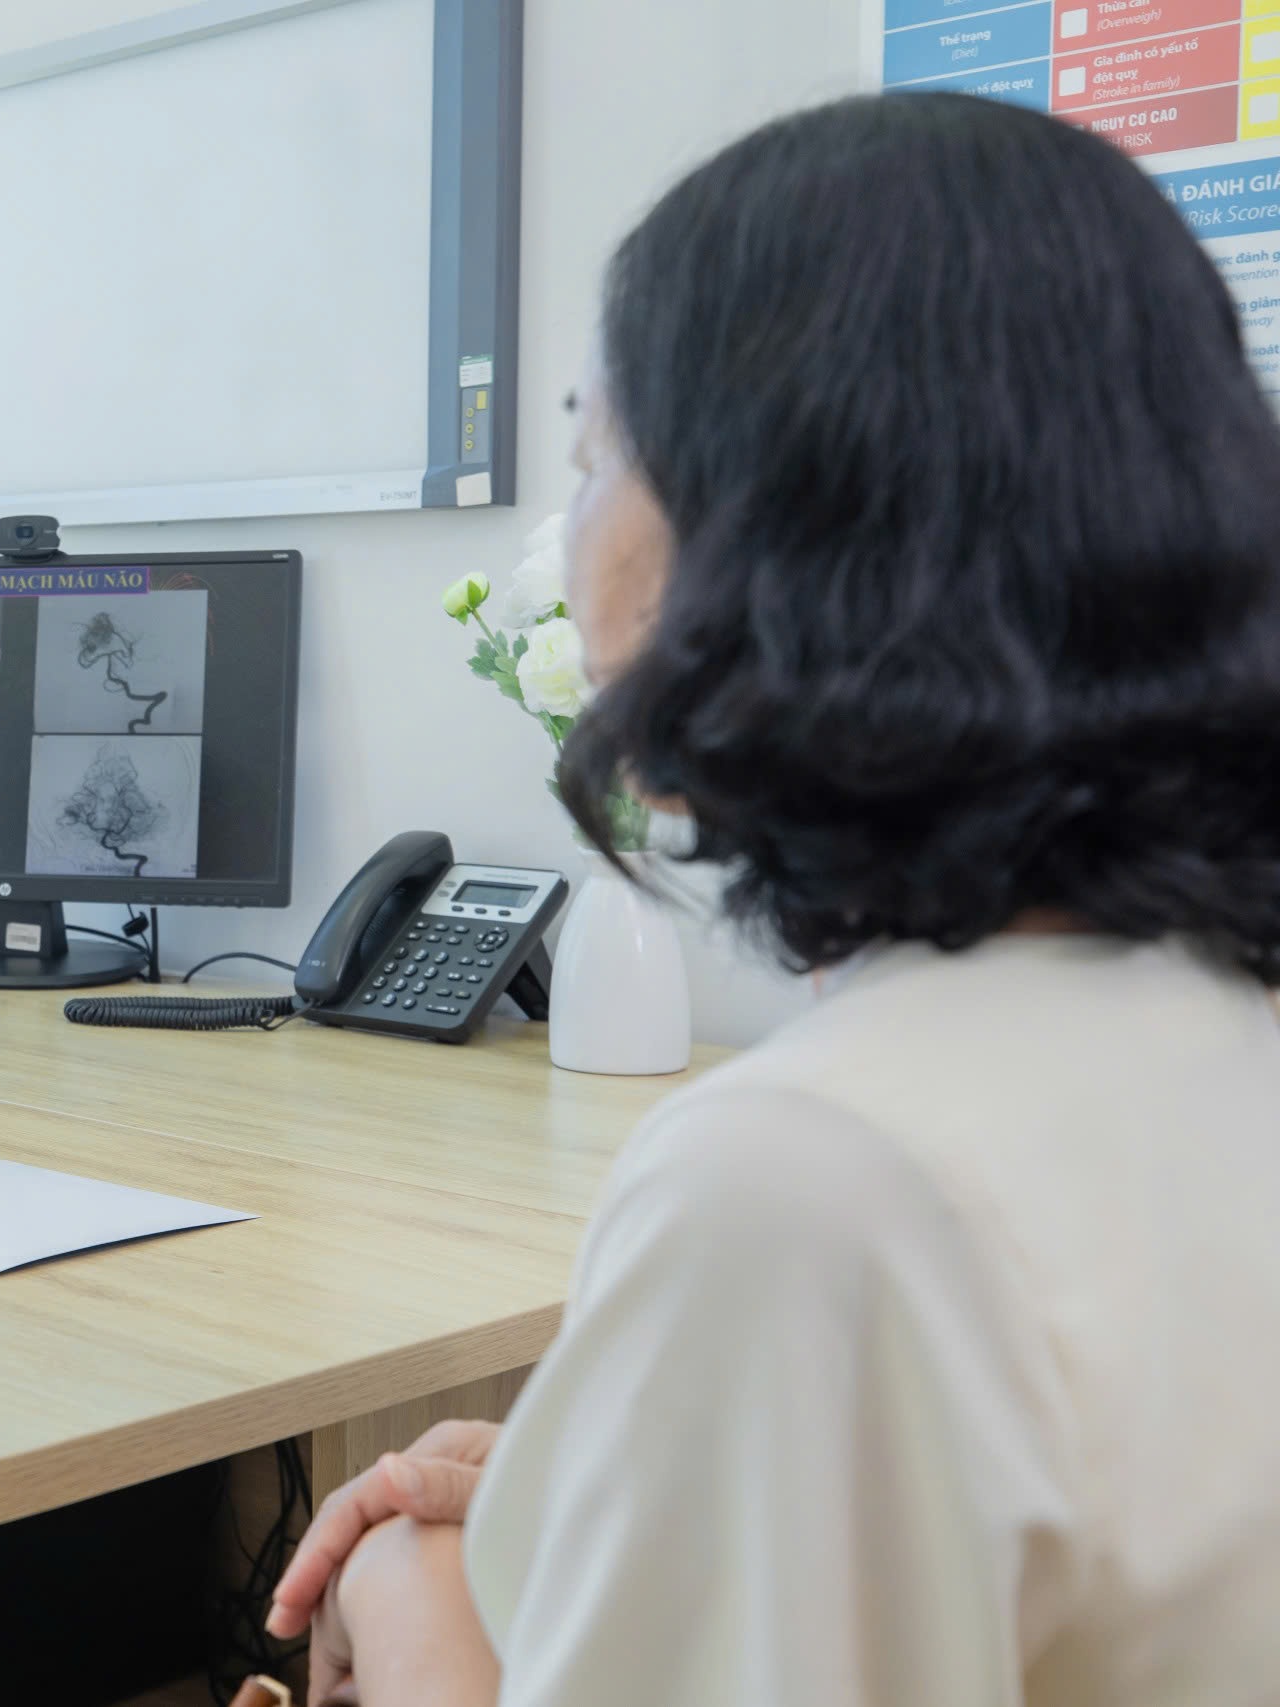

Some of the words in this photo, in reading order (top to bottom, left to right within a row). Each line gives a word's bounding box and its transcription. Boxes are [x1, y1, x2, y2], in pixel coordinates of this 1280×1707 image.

[1093, 55, 1113, 68] Gia
[1091, 116, 1126, 133] NGUY
[1150, 108, 1178, 124] CAO
[1123, 132, 1153, 148] RISK
[1182, 177, 1245, 202] ĐÁNH
[0, 575, 53, 593] MẠCH
[58, 570, 100, 588] MÁU
[104, 570, 143, 588] NÃO
